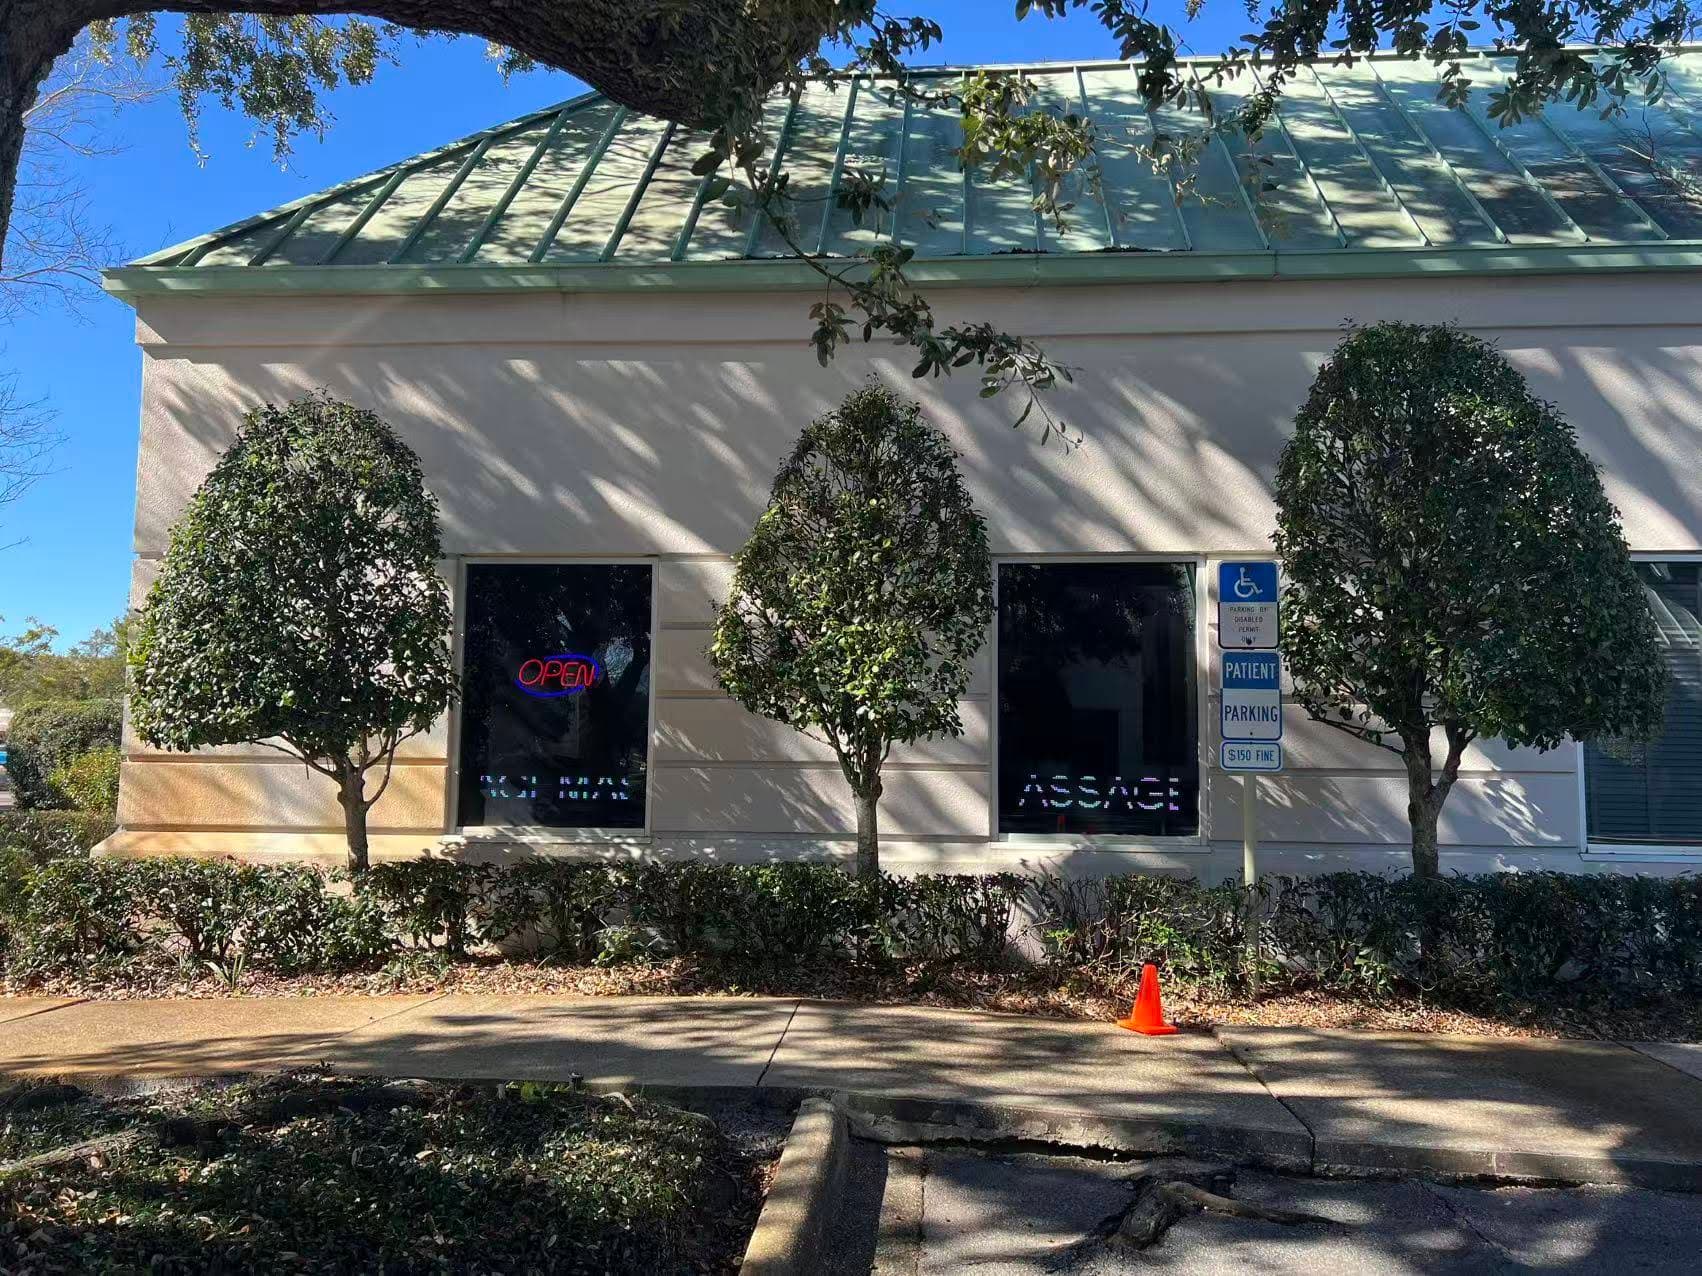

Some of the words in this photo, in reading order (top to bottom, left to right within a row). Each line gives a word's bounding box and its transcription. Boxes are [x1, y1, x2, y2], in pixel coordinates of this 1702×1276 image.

[518, 659, 595, 687] OPEN
[1225, 662, 1276, 679] PATIENT
[1224, 705, 1278, 722] PARKING
[1228, 749, 1251, 761] $150
[1256, 750, 1275, 762] FINE
